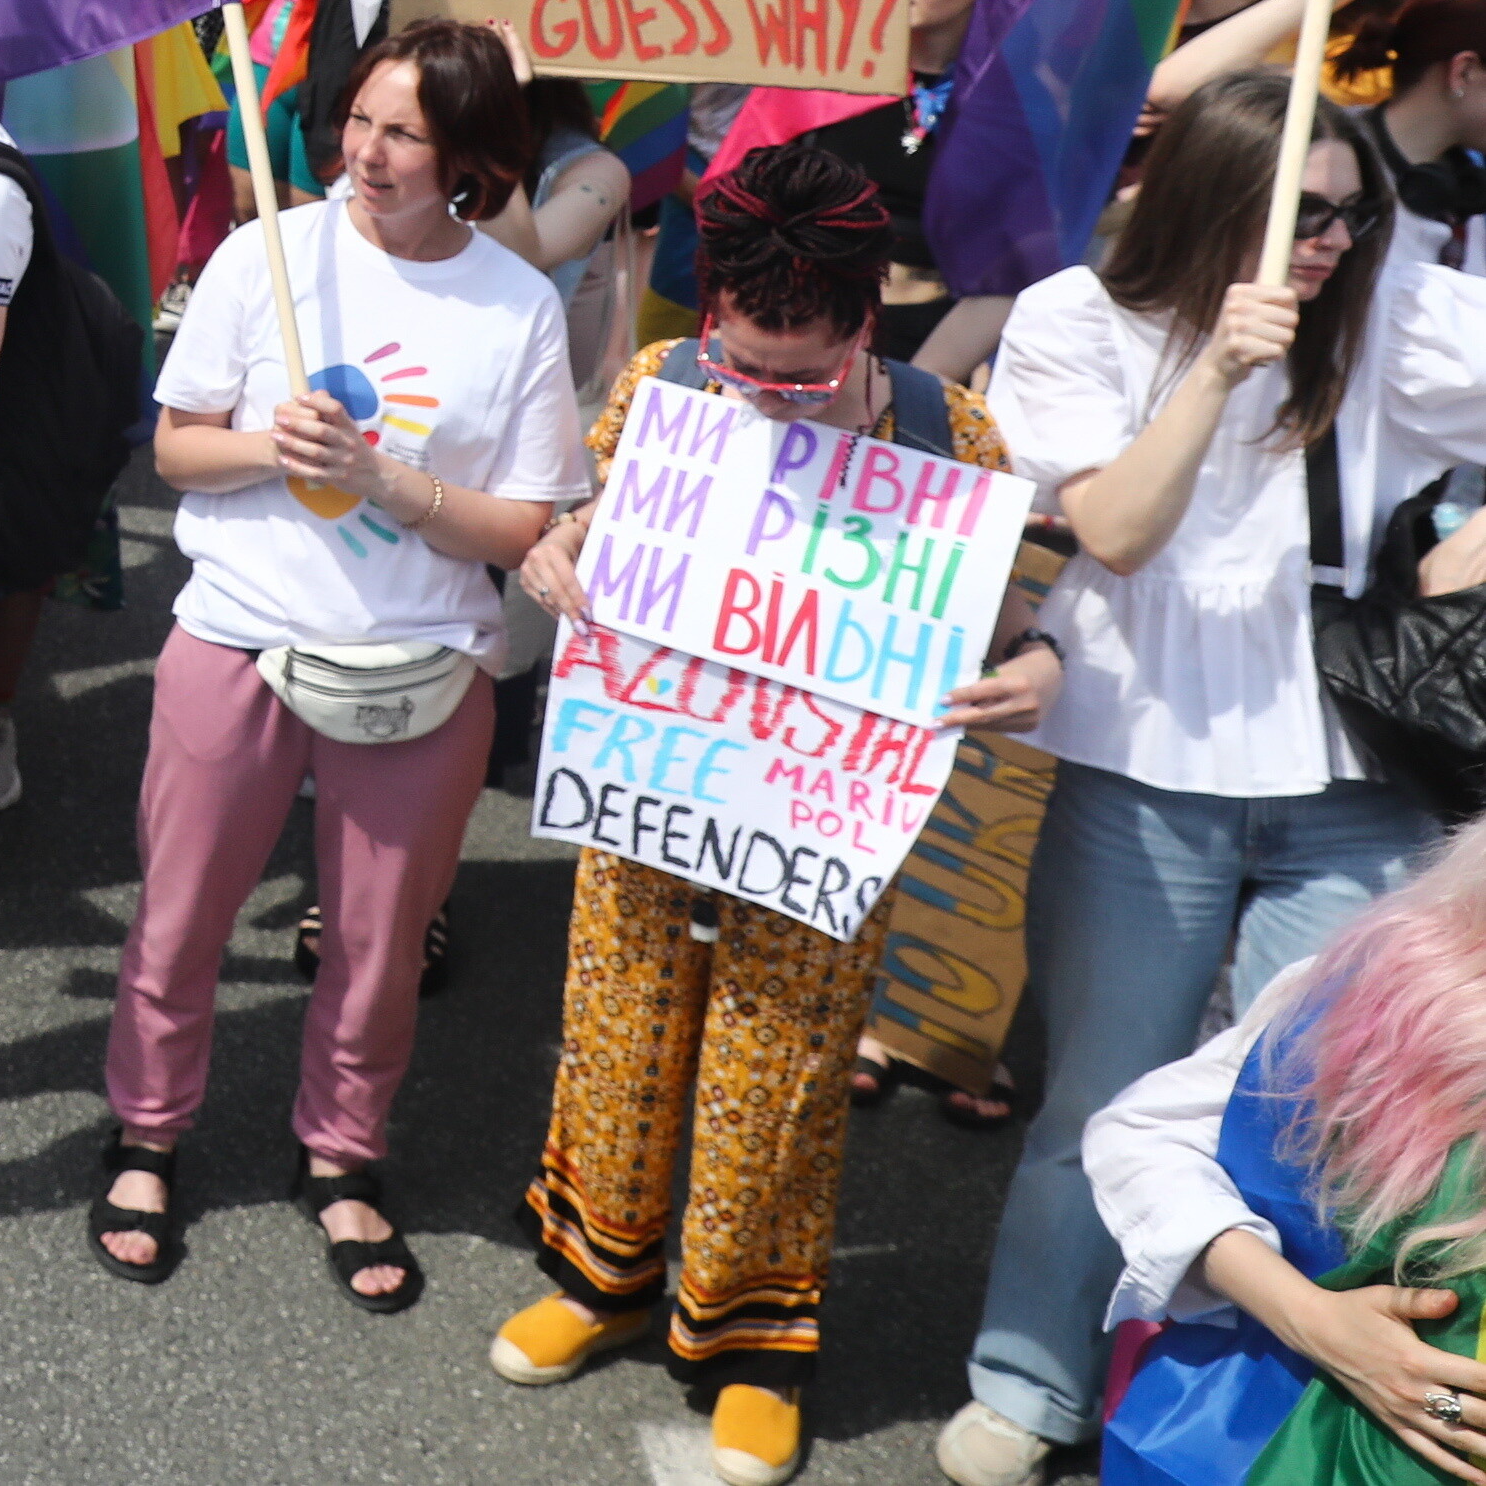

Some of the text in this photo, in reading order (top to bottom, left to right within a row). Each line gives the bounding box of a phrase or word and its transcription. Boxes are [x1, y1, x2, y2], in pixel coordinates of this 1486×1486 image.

[634, 386, 738, 465] МИ
[610, 459, 714, 539] МИ
[588, 534, 692, 633] МИ
[549, 698, 750, 805] FREE
[539, 767, 884, 936] DEFENDERS
[790, 799, 878, 855] POL
